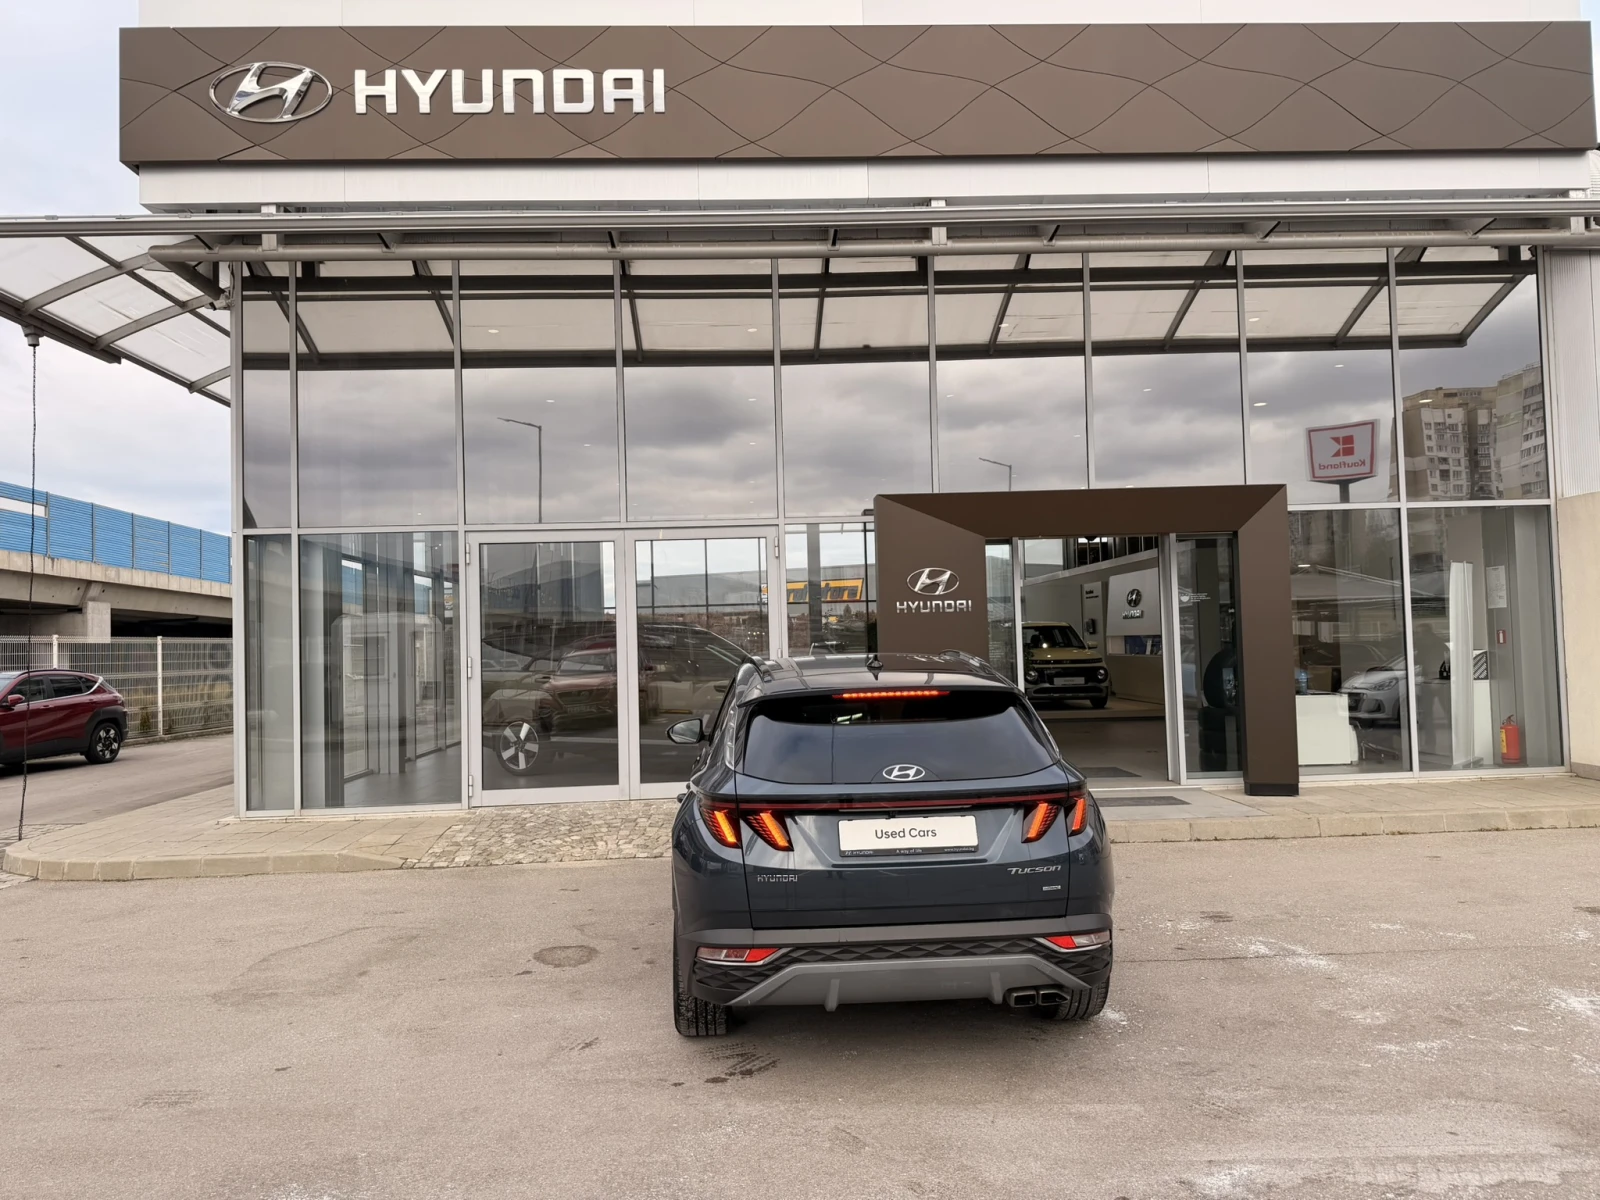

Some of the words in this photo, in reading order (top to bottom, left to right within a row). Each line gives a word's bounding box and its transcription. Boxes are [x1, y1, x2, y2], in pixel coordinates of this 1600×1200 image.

[354, 69, 665, 114] HYUNDAI
[896, 600, 972, 613] HYUNDAI
[875, 828, 906, 839] Used
[908, 827, 937, 838] Cars
[757, 874, 798, 882] HYUNDAI
